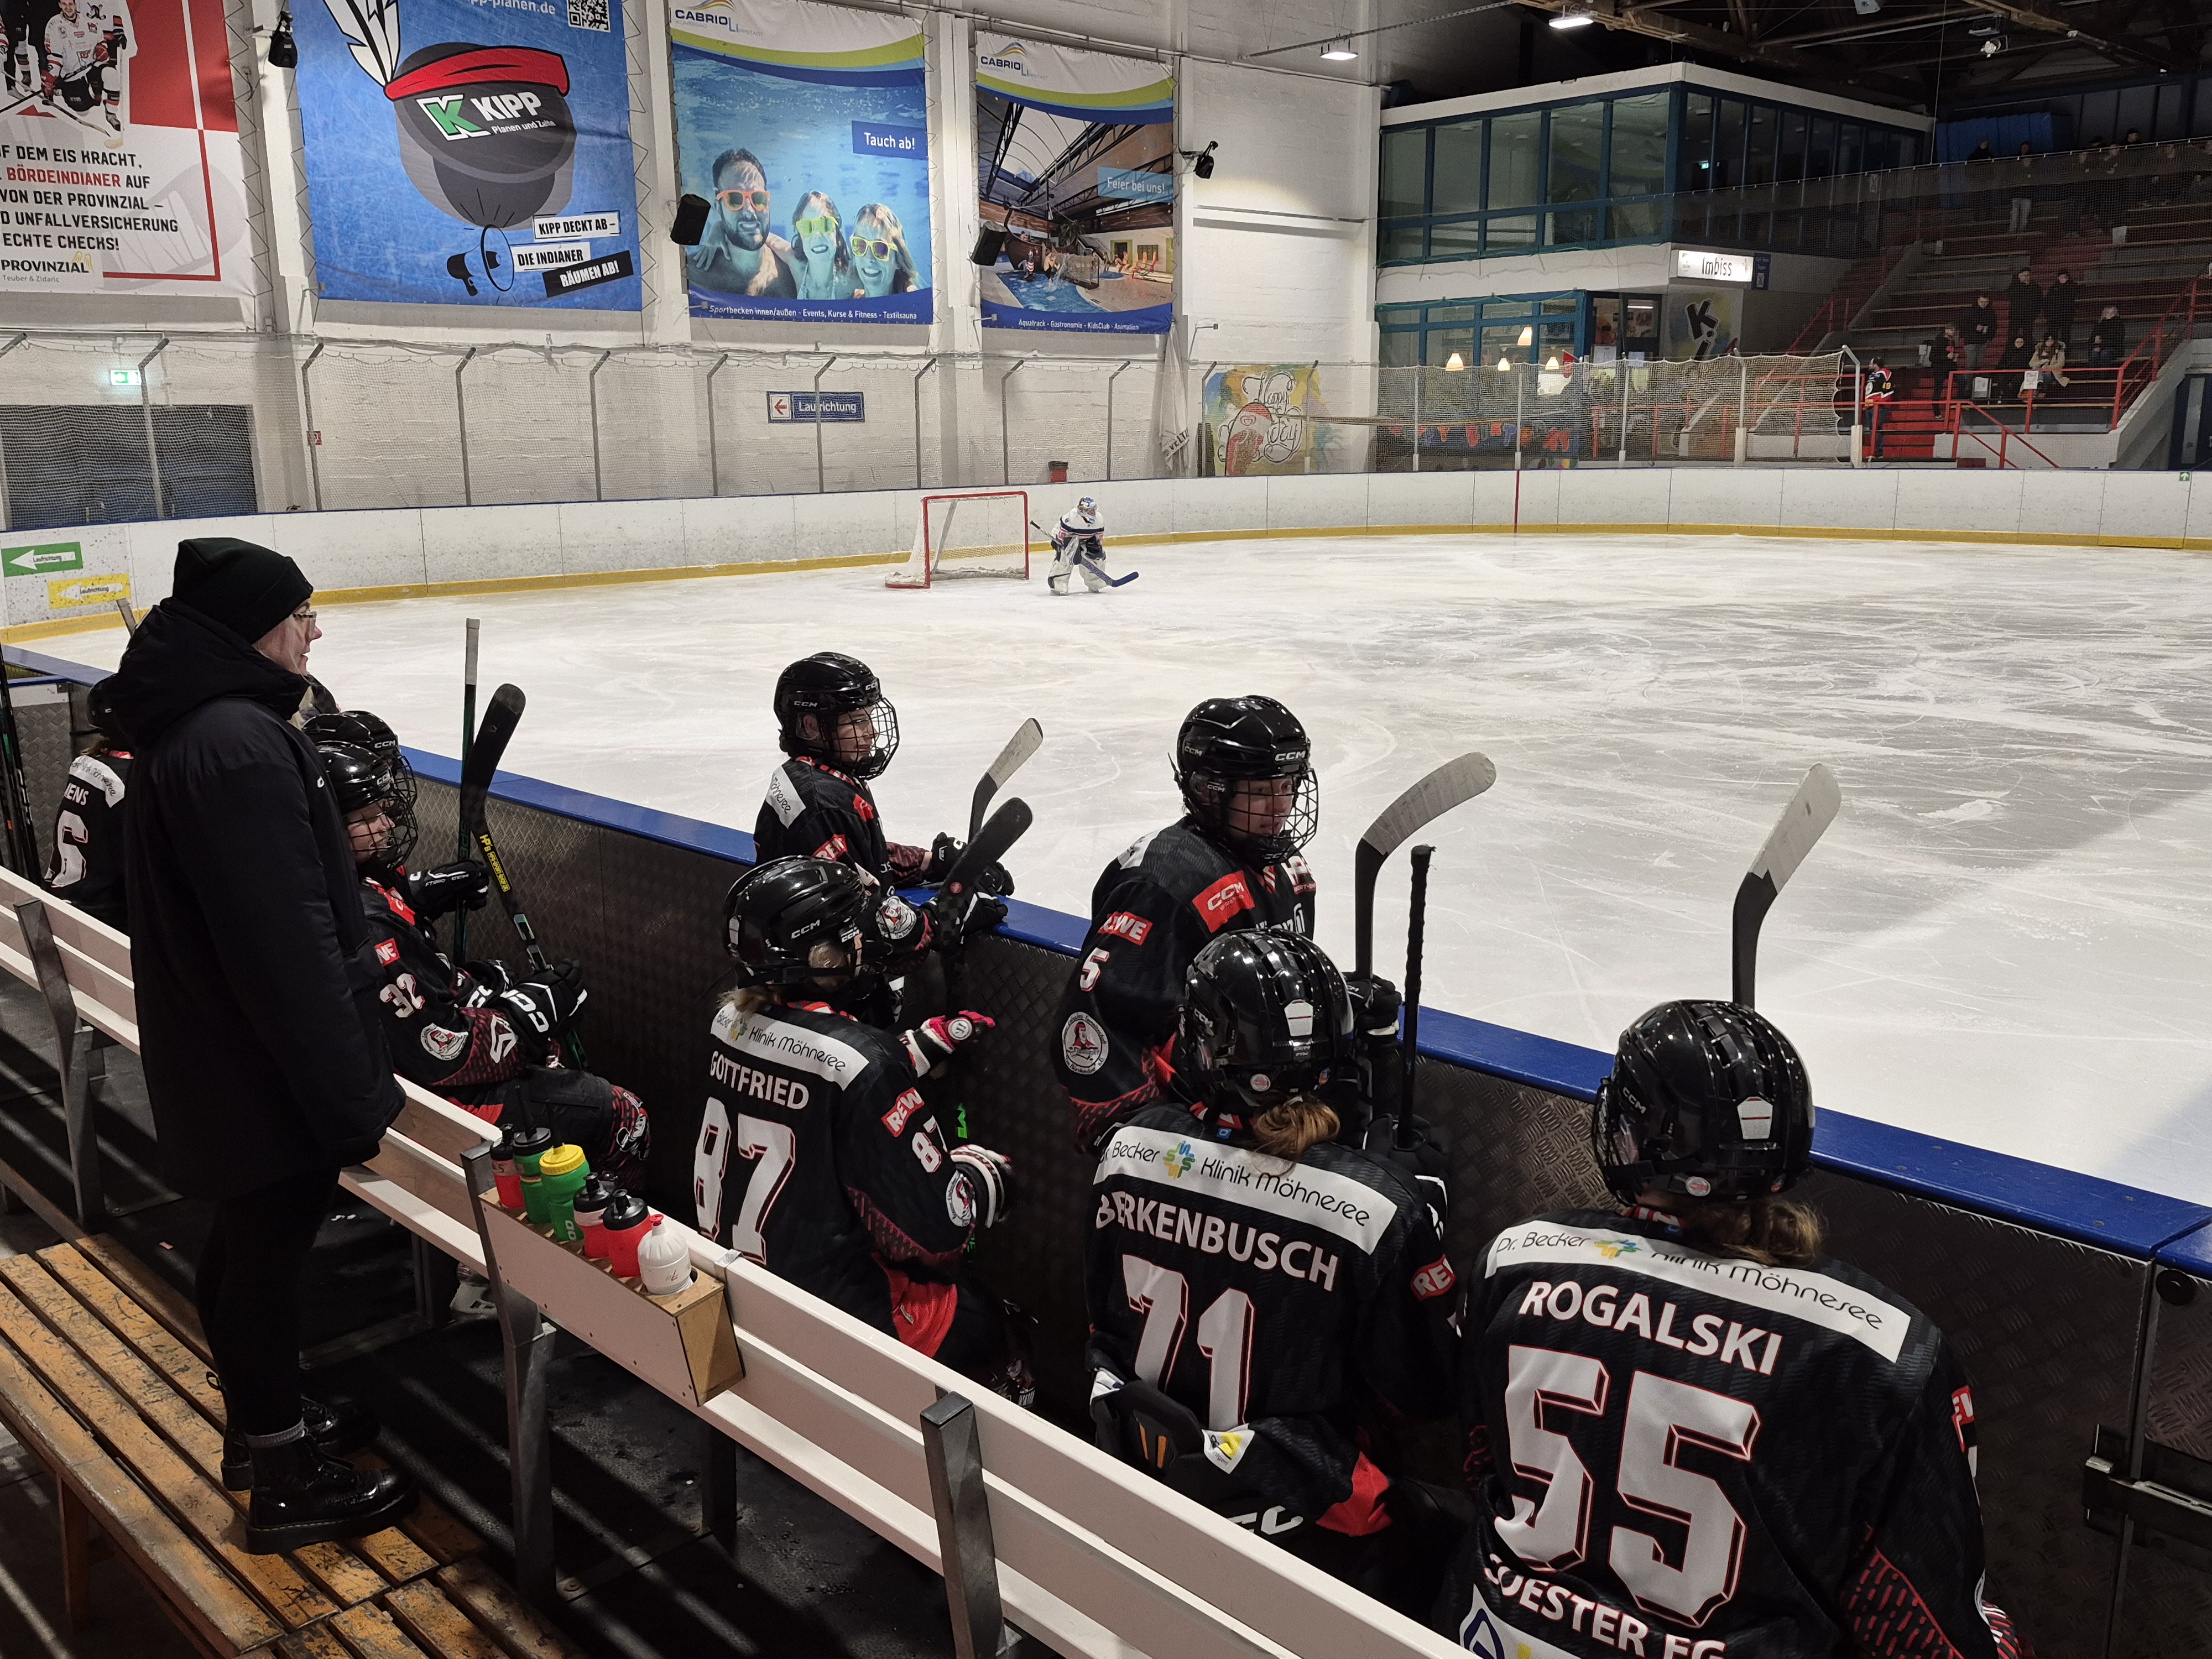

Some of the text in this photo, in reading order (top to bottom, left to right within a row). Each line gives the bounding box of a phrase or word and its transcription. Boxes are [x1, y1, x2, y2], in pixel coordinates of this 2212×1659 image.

[470, 92, 541, 121] KIPP
[491, 124, 521, 134] Planen
[521, 121, 537, 130] und
[864, 132, 916, 150] Tauch ab!
[16, 145, 48, 161] DEM
[53, 148, 76, 163] EIS
[81, 150, 142, 169] KRACHT,
[7, 164, 150, 189] BÖRDEINDIANER AUF
[1107, 176, 1165, 194] Feier bei uns!
[0, 189, 28, 204] VON
[33, 191, 64, 206] DER
[67, 192, 149, 210] PROVINZIAL
[15, 211, 178, 232] UNFALLVERSICHERUNG
[538, 222, 561, 235] KIPP
[563, 219, 593, 233] DECKT
[595, 218, 608, 231] AB
[3, 232, 119, 251] ECHTE CHECKS!
[1, 259, 90, 273] PROVINZIAL
[517, 249, 584, 267] DIE INDIANER
[1702, 256, 1733, 276] Imbiss
[559, 260, 620, 288] RÄUMEN AB!
[709, 305, 754, 317] Sportbecken
[754, 307, 797, 317] innen/außen
[803, 309, 826, 318] Events,
[827, 310, 847, 318] Kurse
[855, 310, 878, 319] Fitness
[883, 311, 917, 320] Textilsauna
[1018, 319, 1046, 327] Aquatrack
[799, 401, 857, 413] Laurichtung
[374, 739, 396, 749] CCM
[1185, 746, 1203, 757] CCM
[1275, 750, 1306, 761] CCM
[1207, 784, 1225, 792] CCM
[1207, 881, 1245, 911] CCM
[791, 919, 821, 939] CCM
[1079, 947, 1110, 992] 5
[379, 973, 426, 1019] 32
[748, 1026, 776, 1047] Klinik
[777, 1036, 846, 1072] Möhnesee
[709, 1050, 810, 1109] GOTTFRIED
[1623, 1086, 1647, 1114] CCM
[1112, 1141, 1161, 1163] Becker
[1200, 1156, 1251, 1187] Klinik
[1255, 1172, 1370, 1227] Möhnesee
[1413, 1257, 1454, 1297] RE
[1496, 1238, 1516, 1254] Dr.
[1521, 1232, 1592, 1249] Becker
[1729, 1265, 1883, 1331] Möhnesee
[1517, 1280, 1783, 1376] ROGALSKI
[1122, 1254, 1256, 1431] 71
[1494, 1344, 1761, 1628] 55
